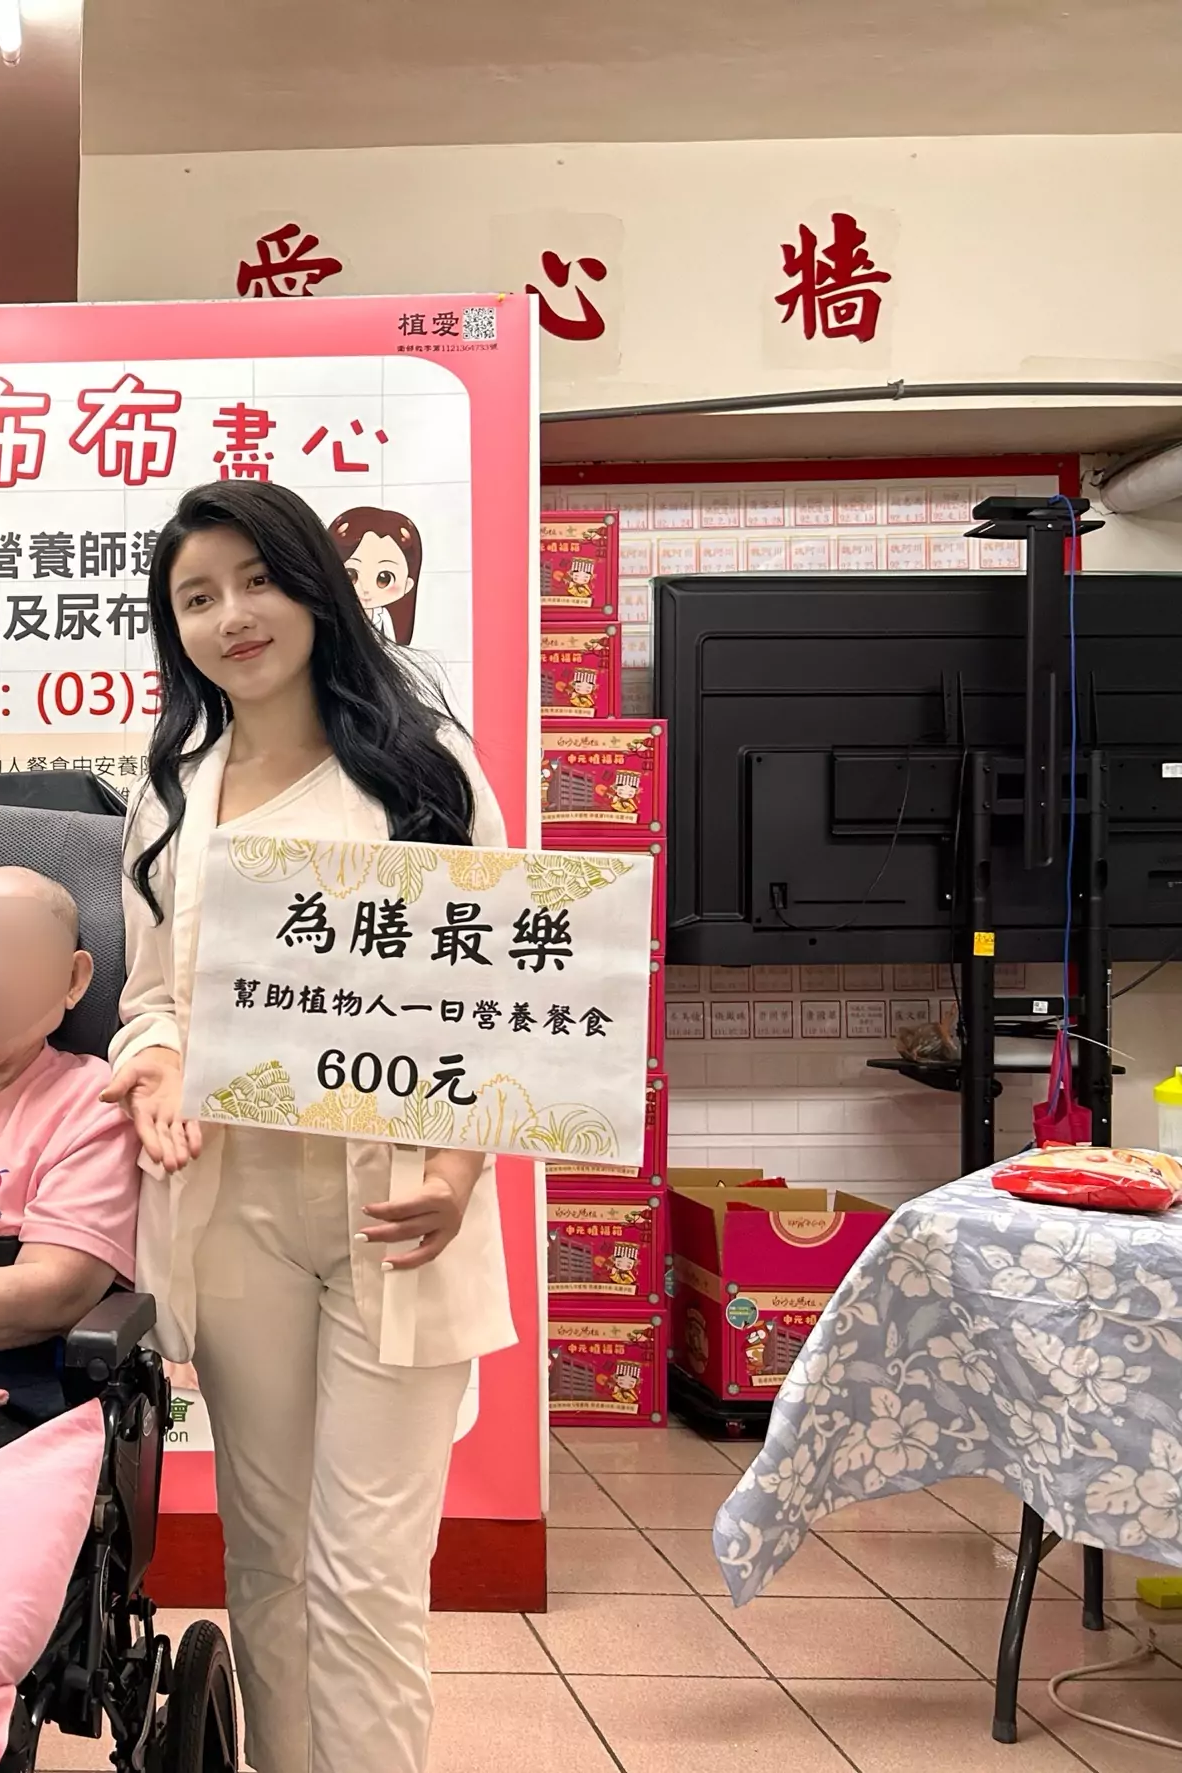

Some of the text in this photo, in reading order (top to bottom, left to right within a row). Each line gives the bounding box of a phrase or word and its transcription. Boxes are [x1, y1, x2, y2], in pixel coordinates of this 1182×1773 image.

[398, 312, 459, 336] 植愛
[276, 891, 574, 973] 為膳最樂
[232, 977, 614, 1037] 幫助植物人一日營養餐食
[317, 1049, 478, 1105] 600元
[171, 1397, 195, 1423] 會
